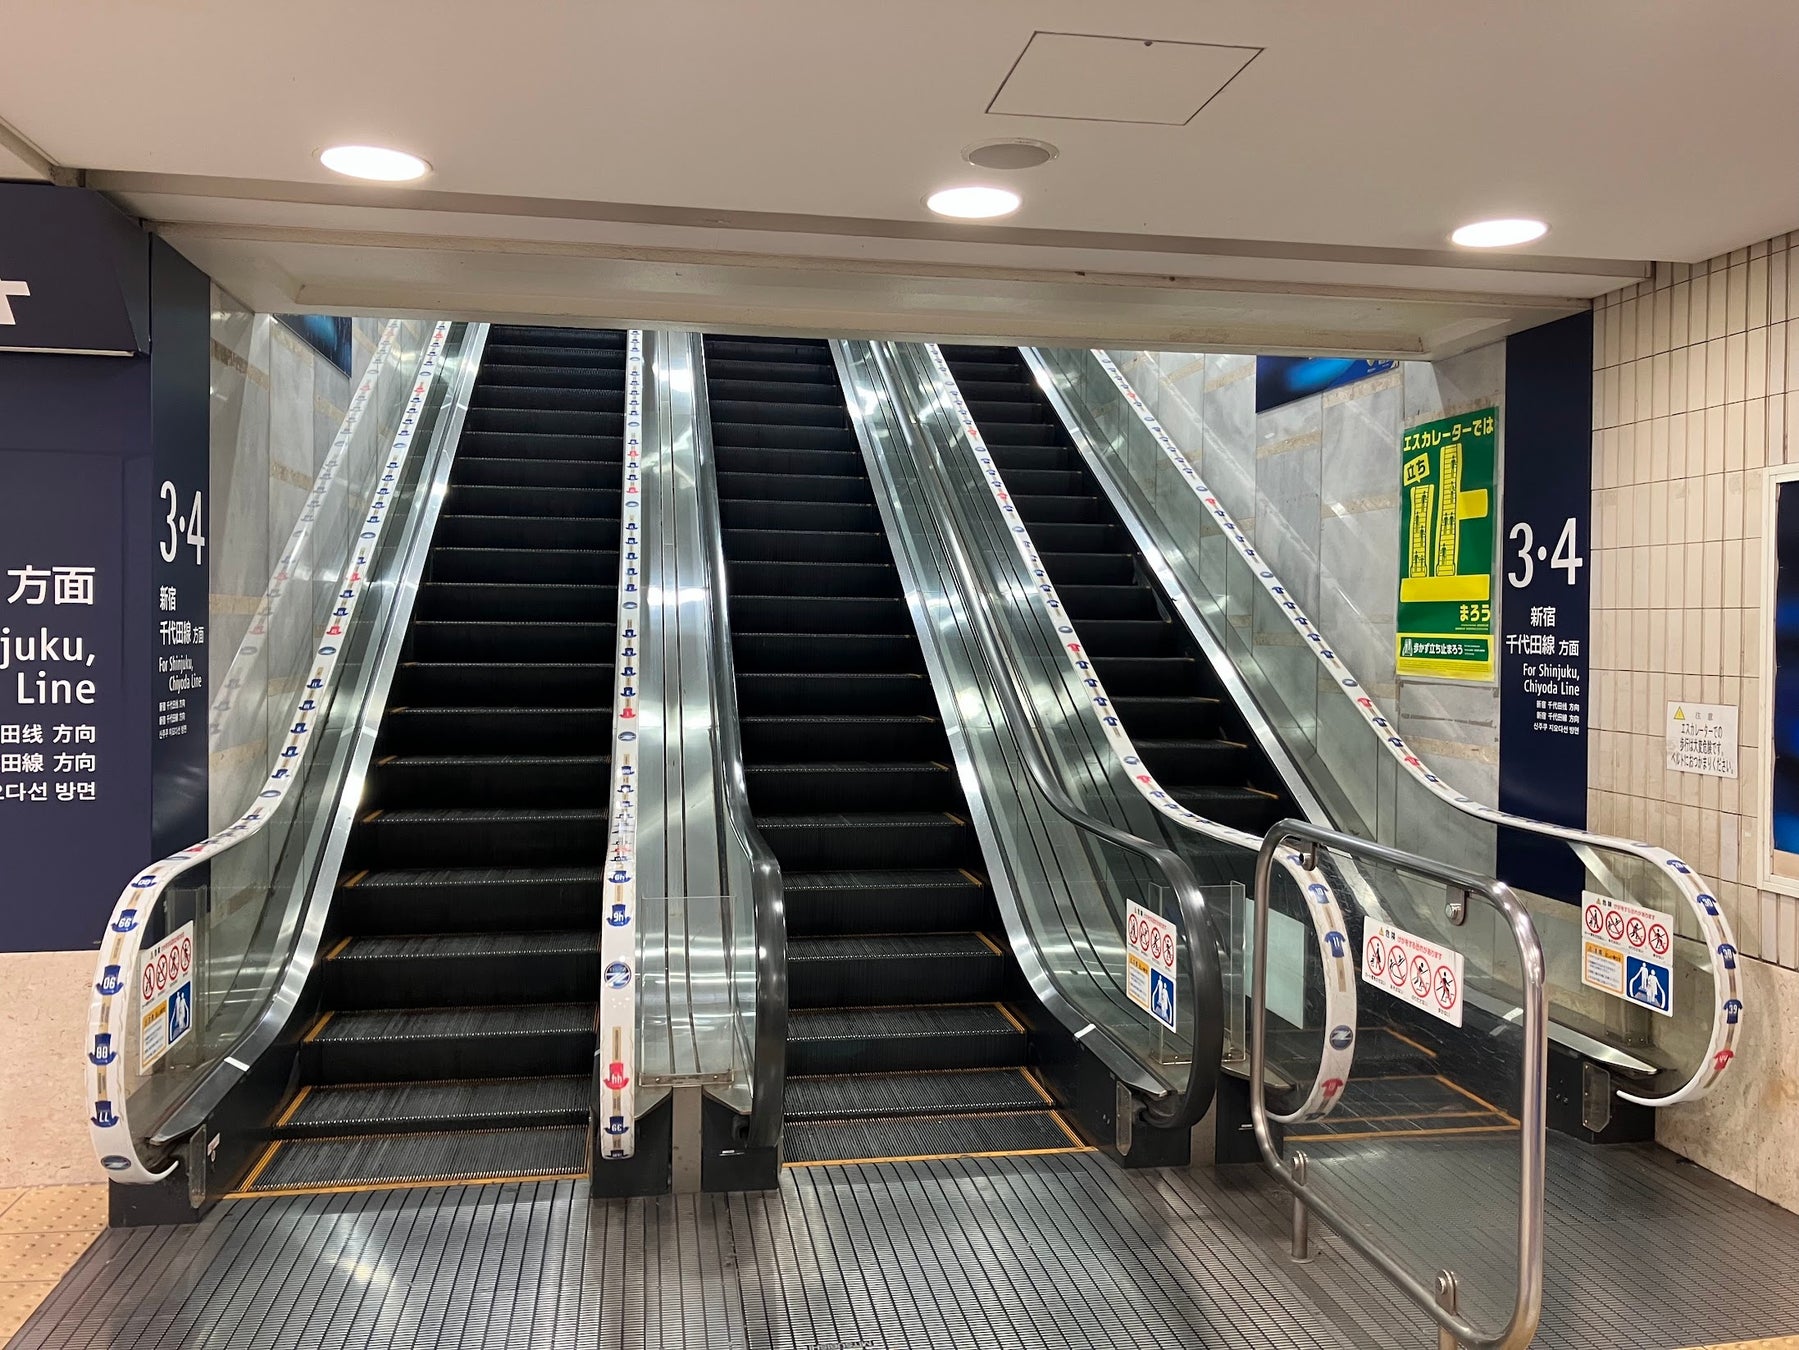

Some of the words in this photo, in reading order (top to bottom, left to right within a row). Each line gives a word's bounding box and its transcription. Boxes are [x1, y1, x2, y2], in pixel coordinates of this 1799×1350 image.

[1403, 416, 1494, 452] エスカレーターでは
[1407, 459, 1426, 481] 立ち
[7, 564, 96, 605] 方面
[160, 585, 176, 611] 新宿
[1459, 604, 1491, 622] まろう
[1530, 606, 1556, 627] 新宿
[160, 620, 191, 645] 千代田線
[193, 626, 204, 644] 方面
[0, 627, 95, 669] juku,
[1413, 642, 1463, 654] 歩かず立ち止まろう
[1506, 634, 1555, 655] 千代田線
[1558, 639, 1580, 656] 方面
[159, 656, 168, 672] For
[1523, 663, 1536, 676] For
[1538, 663, 1580, 681] Shinjuku,
[17, 670, 95, 704] Line
[1523, 679, 1558, 696] Chiyoda
[1560, 681, 1580, 696] Line
[0, 723, 43, 744] 田线
[52, 723, 96, 744] 方向
[1681, 723, 1723, 739] エスカレーターでの
[1, 752, 44, 773] 田線
[53, 752, 96, 773] 方向
[55, 781, 96, 801] 방면
[118, 917, 132, 928] 99
[613, 910, 625, 922] 46
[1333, 936, 1341, 948] 11
[103, 977, 117, 990] 90
[1728, 1004, 1739, 1015] 39
[99, 1111, 110, 1123] 77
[611, 1122, 623, 1133] 39
